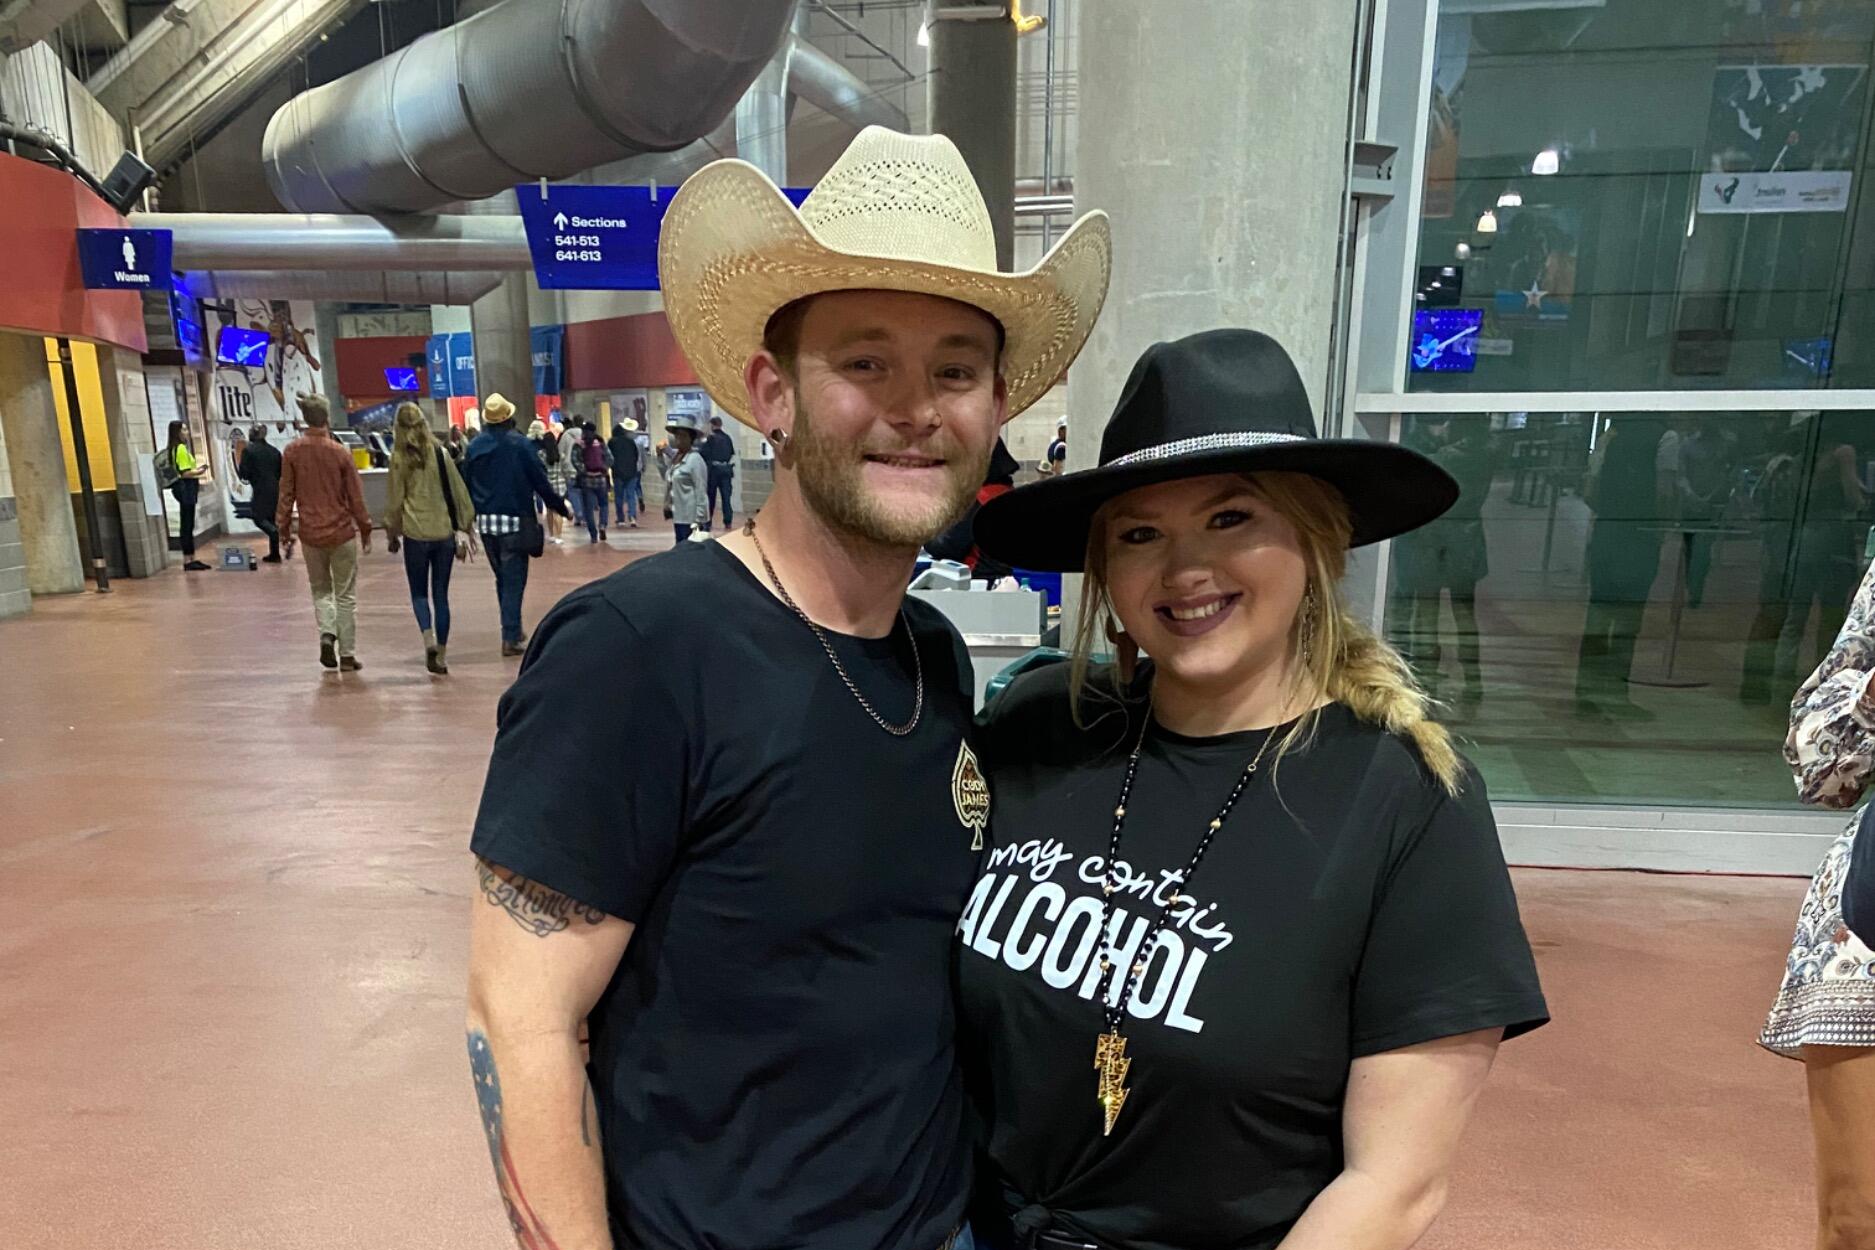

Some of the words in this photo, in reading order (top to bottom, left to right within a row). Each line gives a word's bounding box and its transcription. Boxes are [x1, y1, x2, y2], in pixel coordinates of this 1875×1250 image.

[571, 216, 627, 228] Sections
[555, 236, 600, 247] 541-513
[556, 251, 602, 261] 641-613
[114, 271, 150, 283] Women
[962, 793, 990, 806] JAMES
[987, 838, 1073, 882] may
[1078, 856, 1233, 953] contain
[955, 872, 1208, 1034] ALCOHOL
